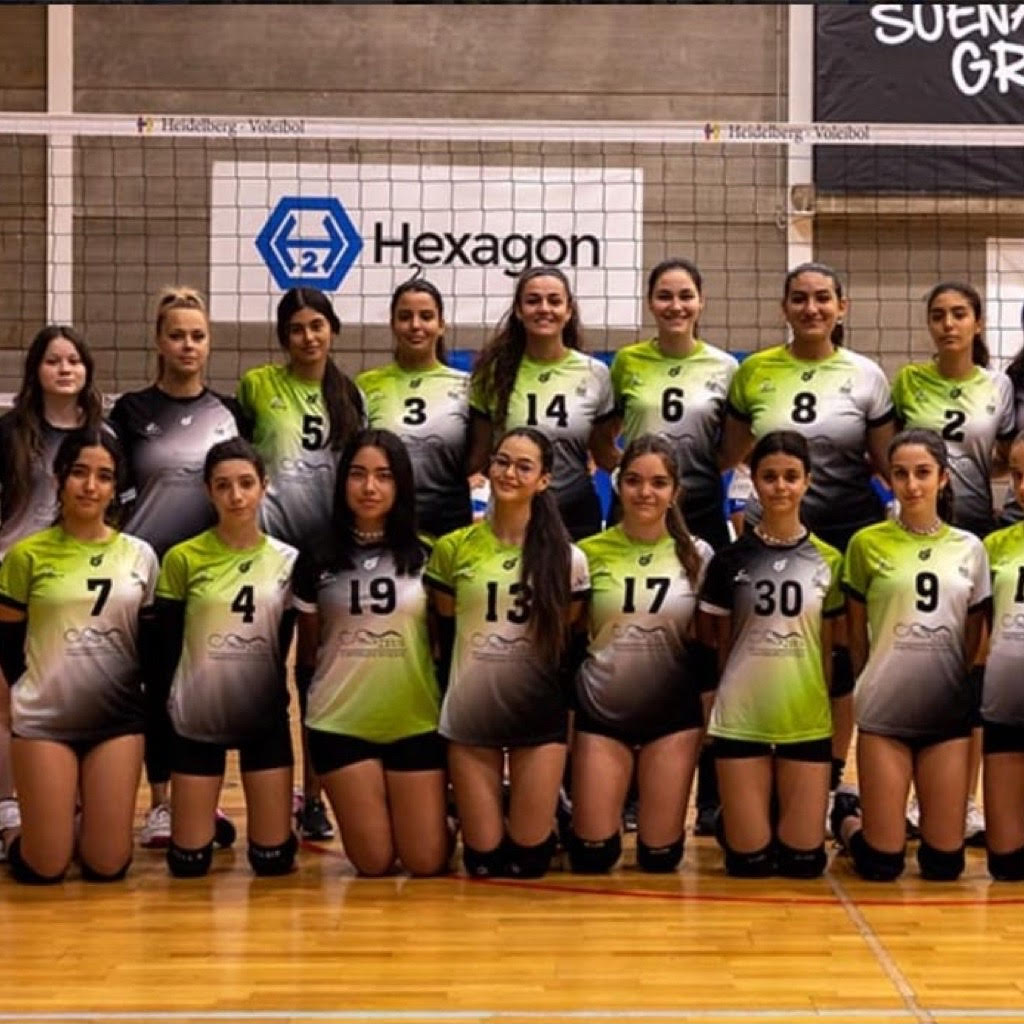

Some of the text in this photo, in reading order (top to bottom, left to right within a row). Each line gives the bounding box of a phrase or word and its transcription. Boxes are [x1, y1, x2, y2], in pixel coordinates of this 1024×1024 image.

[161, 117, 305, 137] Heidelberg Voleibol
[728, 123, 870, 144] Heidelberg Voleibol
[374, 222, 600, 277] Hexagon
[403, 397, 426, 425] 3
[526, 393, 568, 428] 14
[661, 387, 684, 422] 6
[791, 392, 817, 424] 8
[302, 415, 323, 451] 5
[942, 410, 966, 442] 2
[87, 578, 113, 617] 7
[230, 585, 256, 623] 4
[350, 577, 397, 616] 19
[486, 582, 532, 623] 13
[622, 577, 671, 614] 17
[754, 579, 803, 617] 30
[915, 572, 939, 612] 9
